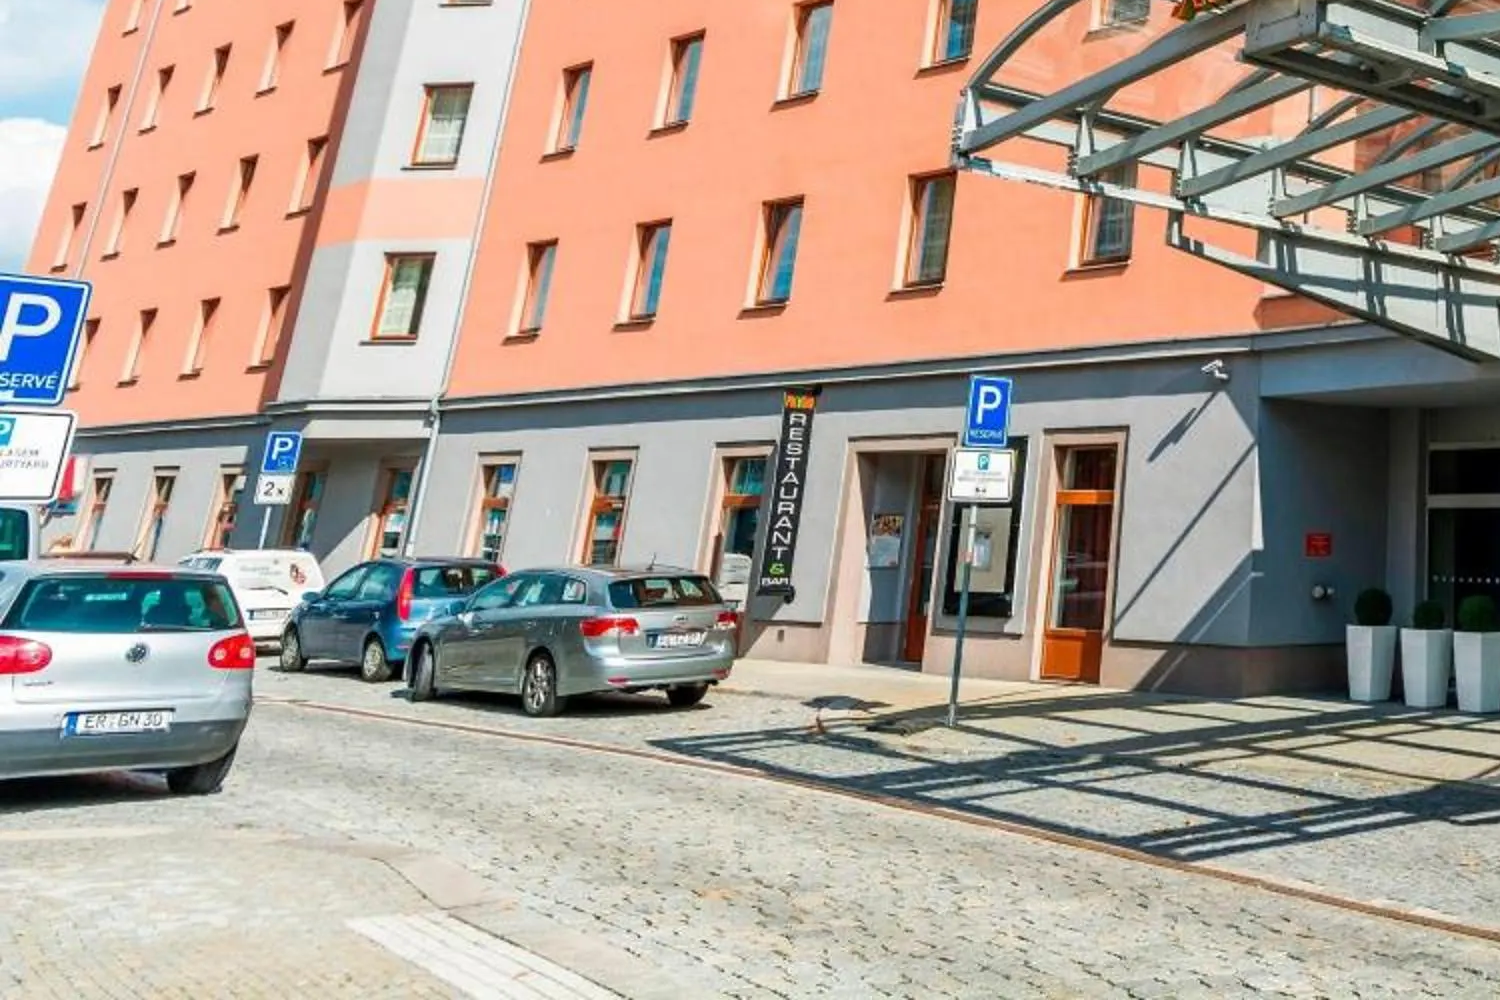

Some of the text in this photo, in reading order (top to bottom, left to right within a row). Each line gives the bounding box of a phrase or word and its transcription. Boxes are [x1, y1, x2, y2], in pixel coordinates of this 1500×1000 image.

[0, 291, 61, 362] P
[977, 385, 1002, 425] P
[271, 437, 294, 460] P
[263, 481, 275, 497] 2
[772, 413, 807, 560] RESTAURANT
[769, 563, 785, 575] &
